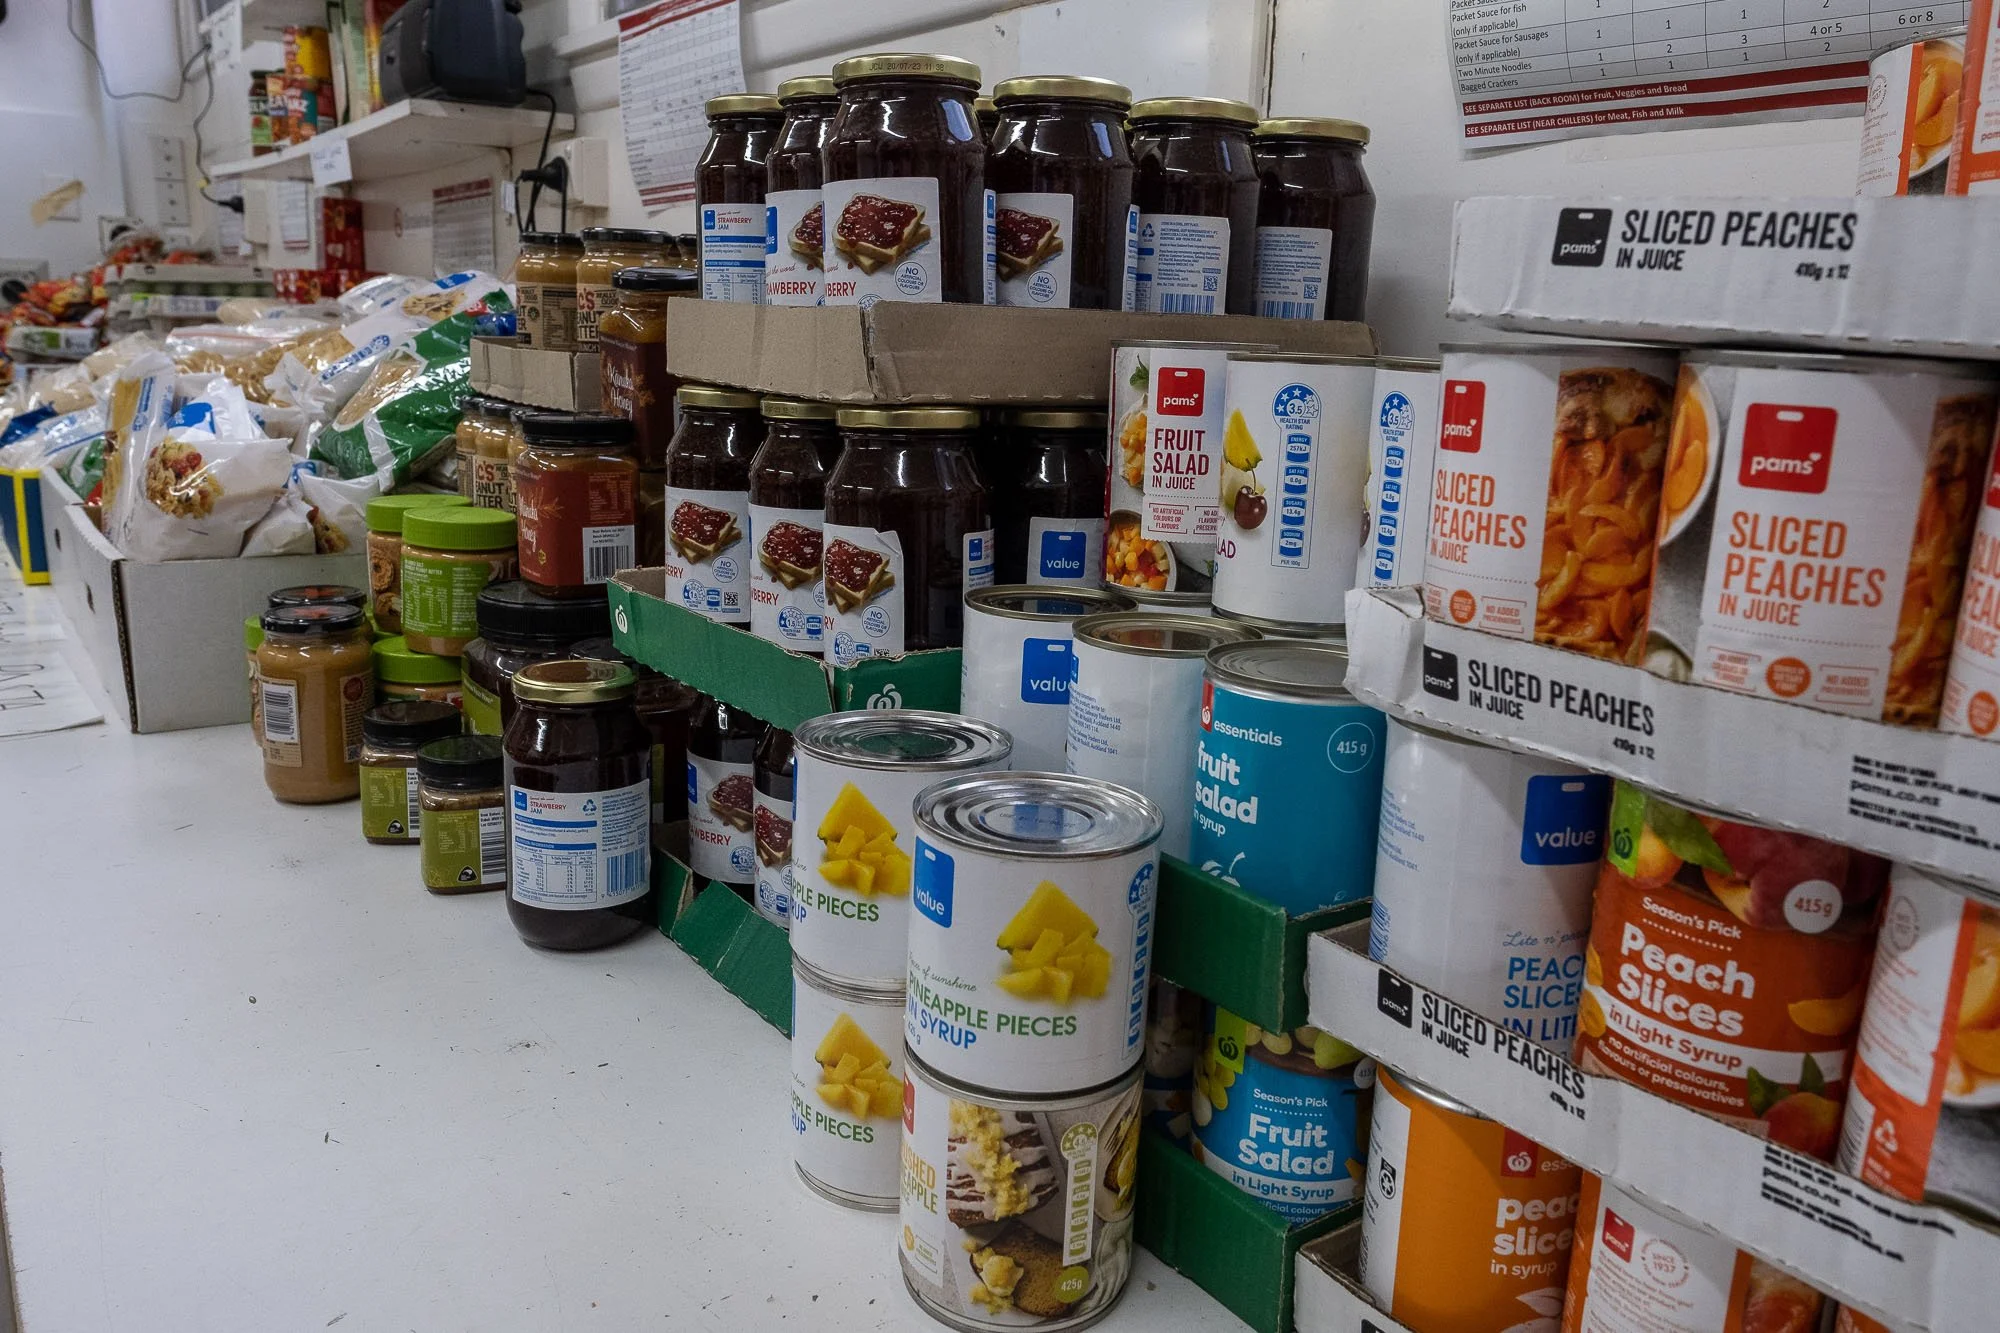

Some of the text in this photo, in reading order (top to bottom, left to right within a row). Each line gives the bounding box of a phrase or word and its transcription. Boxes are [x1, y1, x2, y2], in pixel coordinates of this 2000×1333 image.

[1452, 4, 1526, 22] Packet Sauce for fish
[1741, 9, 1747, 19] 1
[1898, 11, 1934, 25] 6 or 8
[1453, 18, 1518, 37] (only if applicable)
[1597, 30, 1602, 38] 1
[1666, 20, 1671, 29] 1
[1810, 23, 1842, 35] 4 or 5
[1455, 30, 1549, 50] Packet Sauce for Sausages
[1666, 43, 1673, 53] 2
[1741, 34, 1748, 44] 3
[1824, 42, 1831, 51] 2
[1456, 48, 1521, 65] (only if applicable)
[1598, 53, 1603, 61] 1
[1668, 61, 1674, 69] 1
[1743, 52, 1749, 61] 1
[1458, 62, 1532, 77] Two Minute Noodles
[1601, 68, 1606, 76] 1
[1461, 78, 1518, 92] Bagged Crackers
[1465, 83, 1688, 113] SEE SEPARATE LIST (BACK ROOM) for Fruit, Veggies and Bread
[1467, 106, 1685, 135] SEE SEPARATE LIST (NEAR CHILLERS) for Meat, Fish and Milk
[1621, 209, 1858, 251] SLICED PEACHES
[1560, 240, 1598, 256] pams
[1616, 248, 1686, 271] IN JUICE
[904, 266, 919, 275] NO
[1037, 275, 1049, 284] NO
[766, 281, 817, 296] RAWBERRY
[1163, 395, 1196, 408] pams
[1289, 403, 1303, 415] 3.5
[1388, 413, 1399, 426] 3.5
[1444, 421, 1474, 438] pams
[1154, 428, 1206, 452] FRUIT
[1152, 452, 1209, 476] SALAD
[1751, 453, 1814, 475] pams
[1152, 475, 1196, 490] IN JUICE
[1436, 469, 1495, 507] SLICED
[1152, 507, 1185, 517] NO ARTIFICIAL
[1153, 514, 1182, 523] COLOURS OR
[1155, 522, 1180, 531] FLAVOURS
[1433, 504, 1527, 549] PEACHES
[1728, 510, 1848, 559] SLICED
[1430, 540, 1468, 563] IN JUICE
[720, 560, 731, 568] NO
[1047, 558, 1080, 569] value
[1722, 553, 1887, 608] PEACHES
[870, 610, 883, 619] NO
[1485, 604, 1520, 618] NO ADDED
[1718, 593, 1802, 627] IN JUICE
[788, 619, 796, 627] 1.5
[1425, 674, 1452, 690] pams
[1468, 659, 1655, 737] SLICED PEACHES
[1469, 690, 1524, 720] IN JUICE
[1213, 719, 1283, 746] essentials
[1198, 740, 1241, 786] fruit
[530, 801, 567, 811] STRAWBERRY
[1195, 780, 1258, 825] salad
[1193, 804, 1226, 837] in syrup
[1535, 827, 1597, 849] value
[817, 895, 880, 922] PIECES
[916, 886, 945, 916] value
[1642, 896, 1742, 940] Season's Pick
[1503, 930, 1539, 947] Lite
[1508, 955, 1585, 982] PEAC
[1621, 922, 1755, 999] Peach
[931, 972, 977, 992] sunshine
[909, 970, 1077, 1037] PINEAPPLE PIECES
[1382, 996, 1407, 1017] pams
[1617, 963, 1744, 1037] Slices
[908, 995, 977, 1050] IN SYRUP
[1541, 1014, 1577, 1041] LIT
[1422, 1020, 1469, 1059] IN JUICE
[1422, 993, 1585, 1100] SLICED PEACHES
[1608, 1004, 1742, 1072] in Light Syrup
[1598, 1040, 1745, 1109] flavours or preservatives
[1609, 1036, 1730, 1093] no artificial colours,
[1253, 1088, 1328, 1108] Season's Pick
[815, 1116, 874, 1143] PIECES
[1249, 1112, 1327, 1148] Fruit
[902, 1142, 936, 1191] USHED
[1238, 1138, 1335, 1175] Salad
[1232, 1170, 1334, 1200] in Light Syrup
[1496, 1193, 1579, 1229] peac
[1490, 1259, 1557, 1279] in syrup
[1061, 1278, 1083, 1292] 425g
